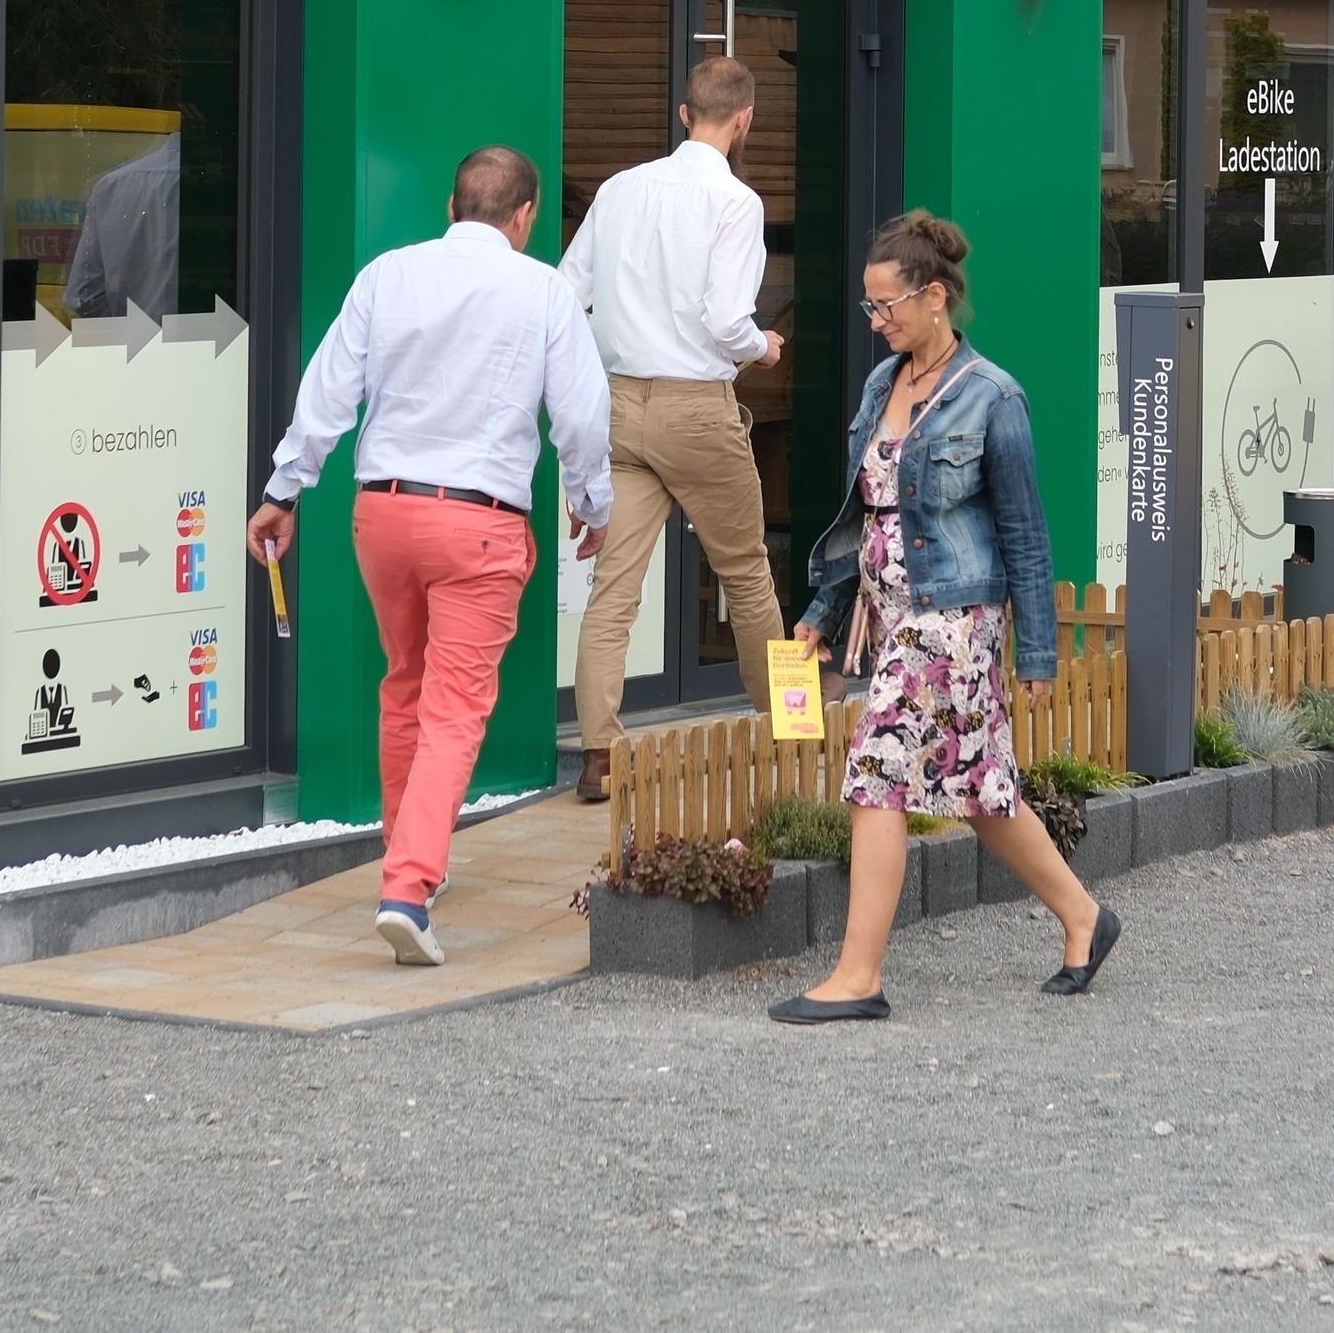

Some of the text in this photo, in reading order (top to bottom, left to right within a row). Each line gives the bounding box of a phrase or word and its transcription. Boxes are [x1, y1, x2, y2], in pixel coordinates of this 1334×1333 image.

[1246, 79, 1295, 115] eBike
[1219, 136, 1320, 173] Ladestation
[92, 424, 177, 453] bezahlen
[1131, 378, 1152, 523] Kundenkarte
[1151, 357, 1173, 542] Personalausweis
[178, 490, 206, 508] VISA
[190, 627, 218, 646] VISA
